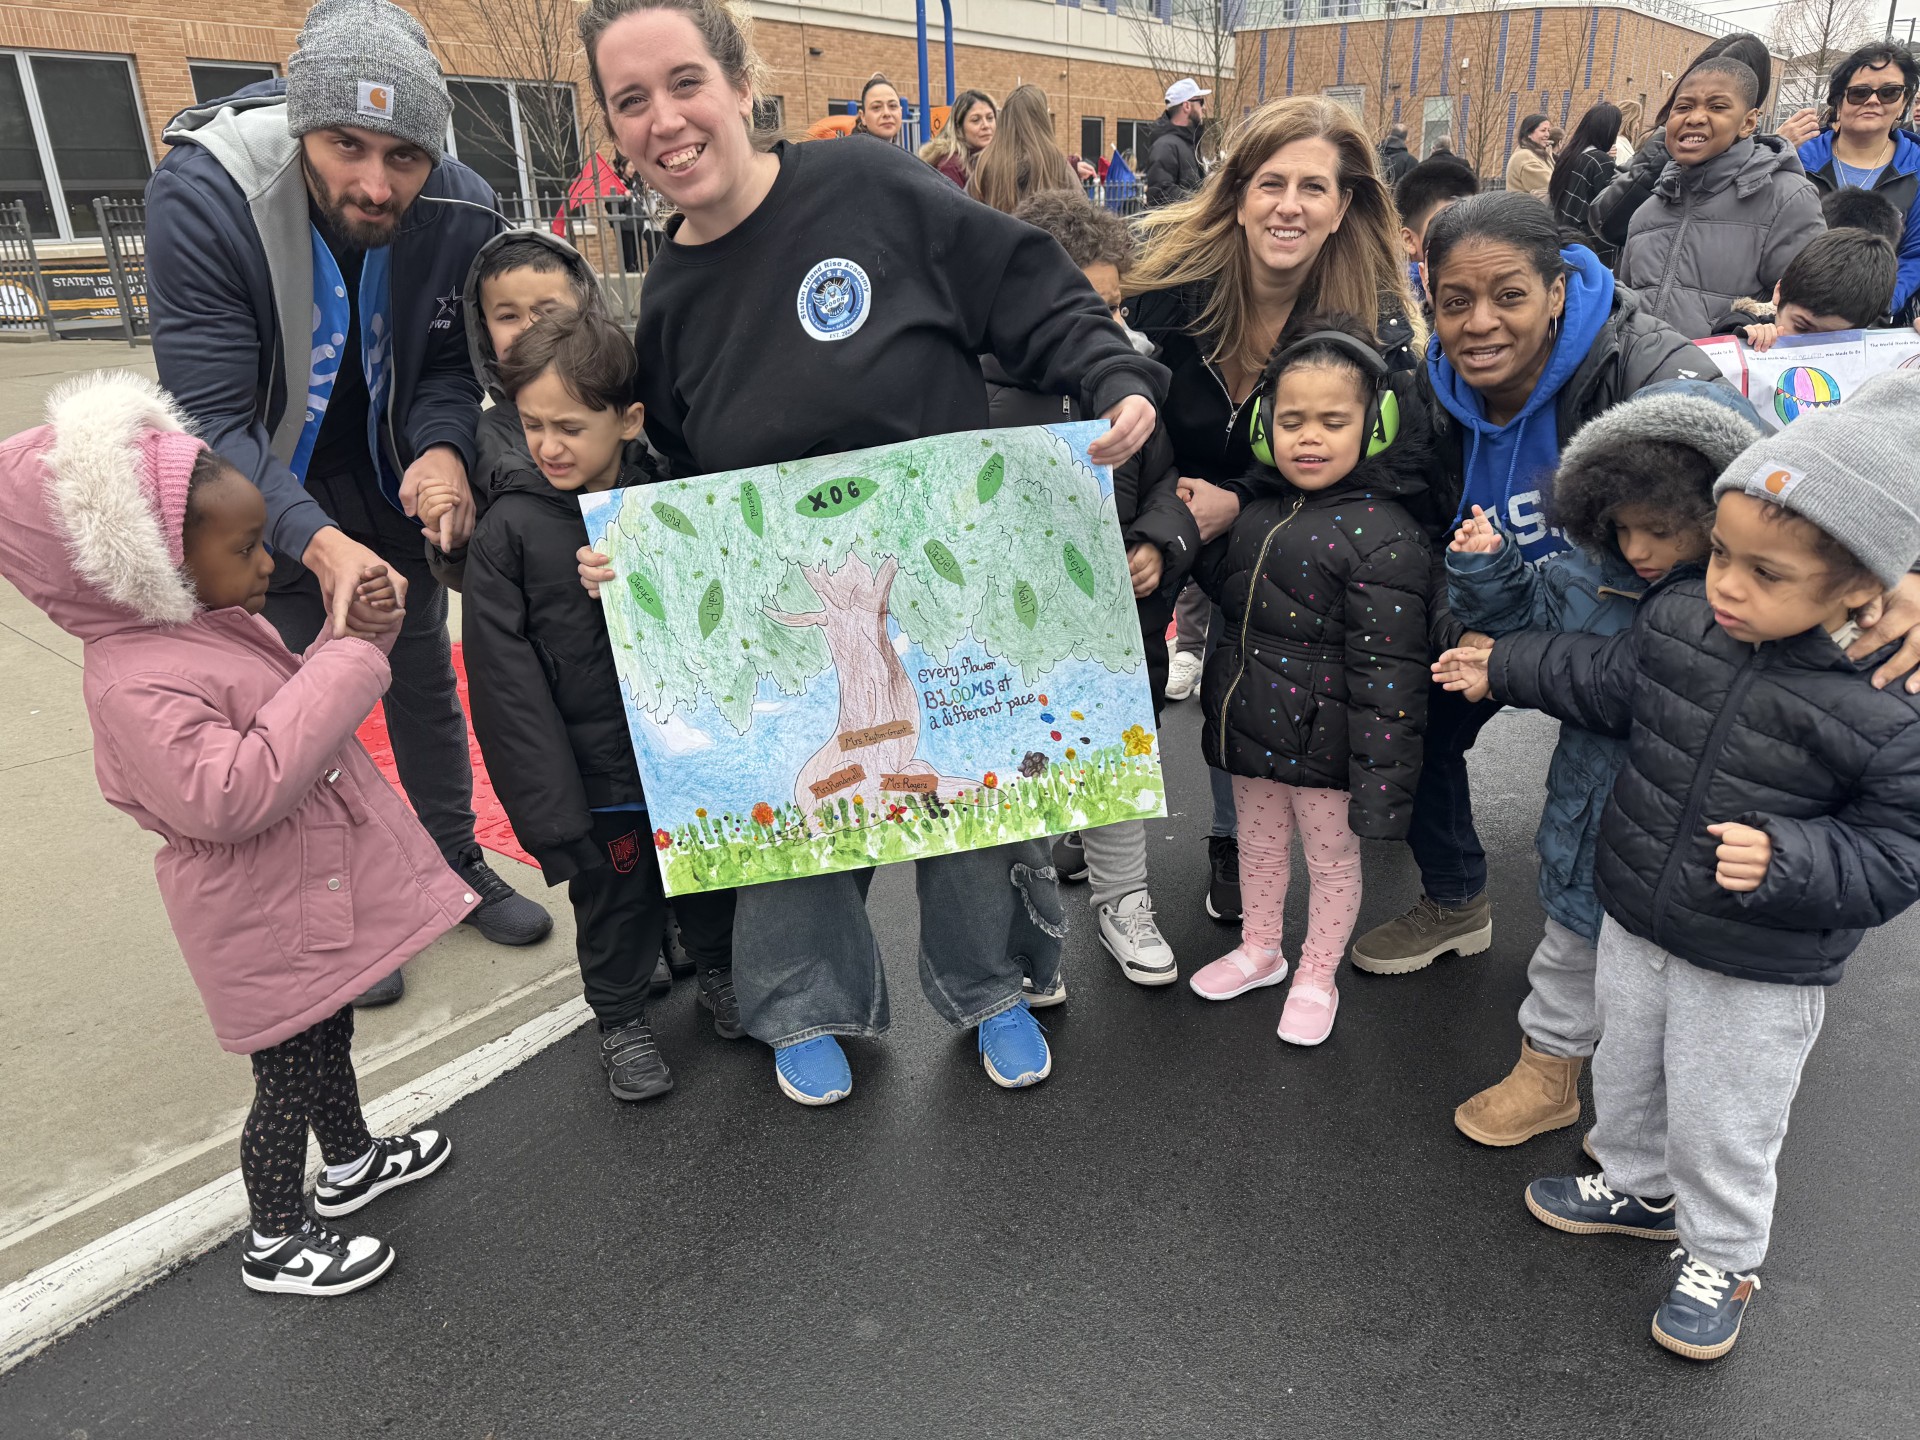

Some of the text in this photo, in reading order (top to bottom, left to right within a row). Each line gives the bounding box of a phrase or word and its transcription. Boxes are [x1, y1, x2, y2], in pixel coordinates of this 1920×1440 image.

[52, 275, 96, 288] STATEN
[93, 286, 117, 297] HIG
[803, 265, 823, 287] Island
[823, 260, 842, 269] Rise
[843, 261, 870, 293] Academy
[982, 458, 1003, 482] Ares
[656, 504, 681, 529] Aisha
[928, 542, 956, 573] Jaziel
[1063, 544, 1087, 579] Joseph
[630, 573, 654, 605] Jaeyce
[1016, 584, 1034, 608] Noah
[917, 656, 997, 687] every flower
[923, 673, 1013, 710] BLOOMS at
[929, 693, 1037, 731] a different pace
[902, 776, 929, 792] Rogers
